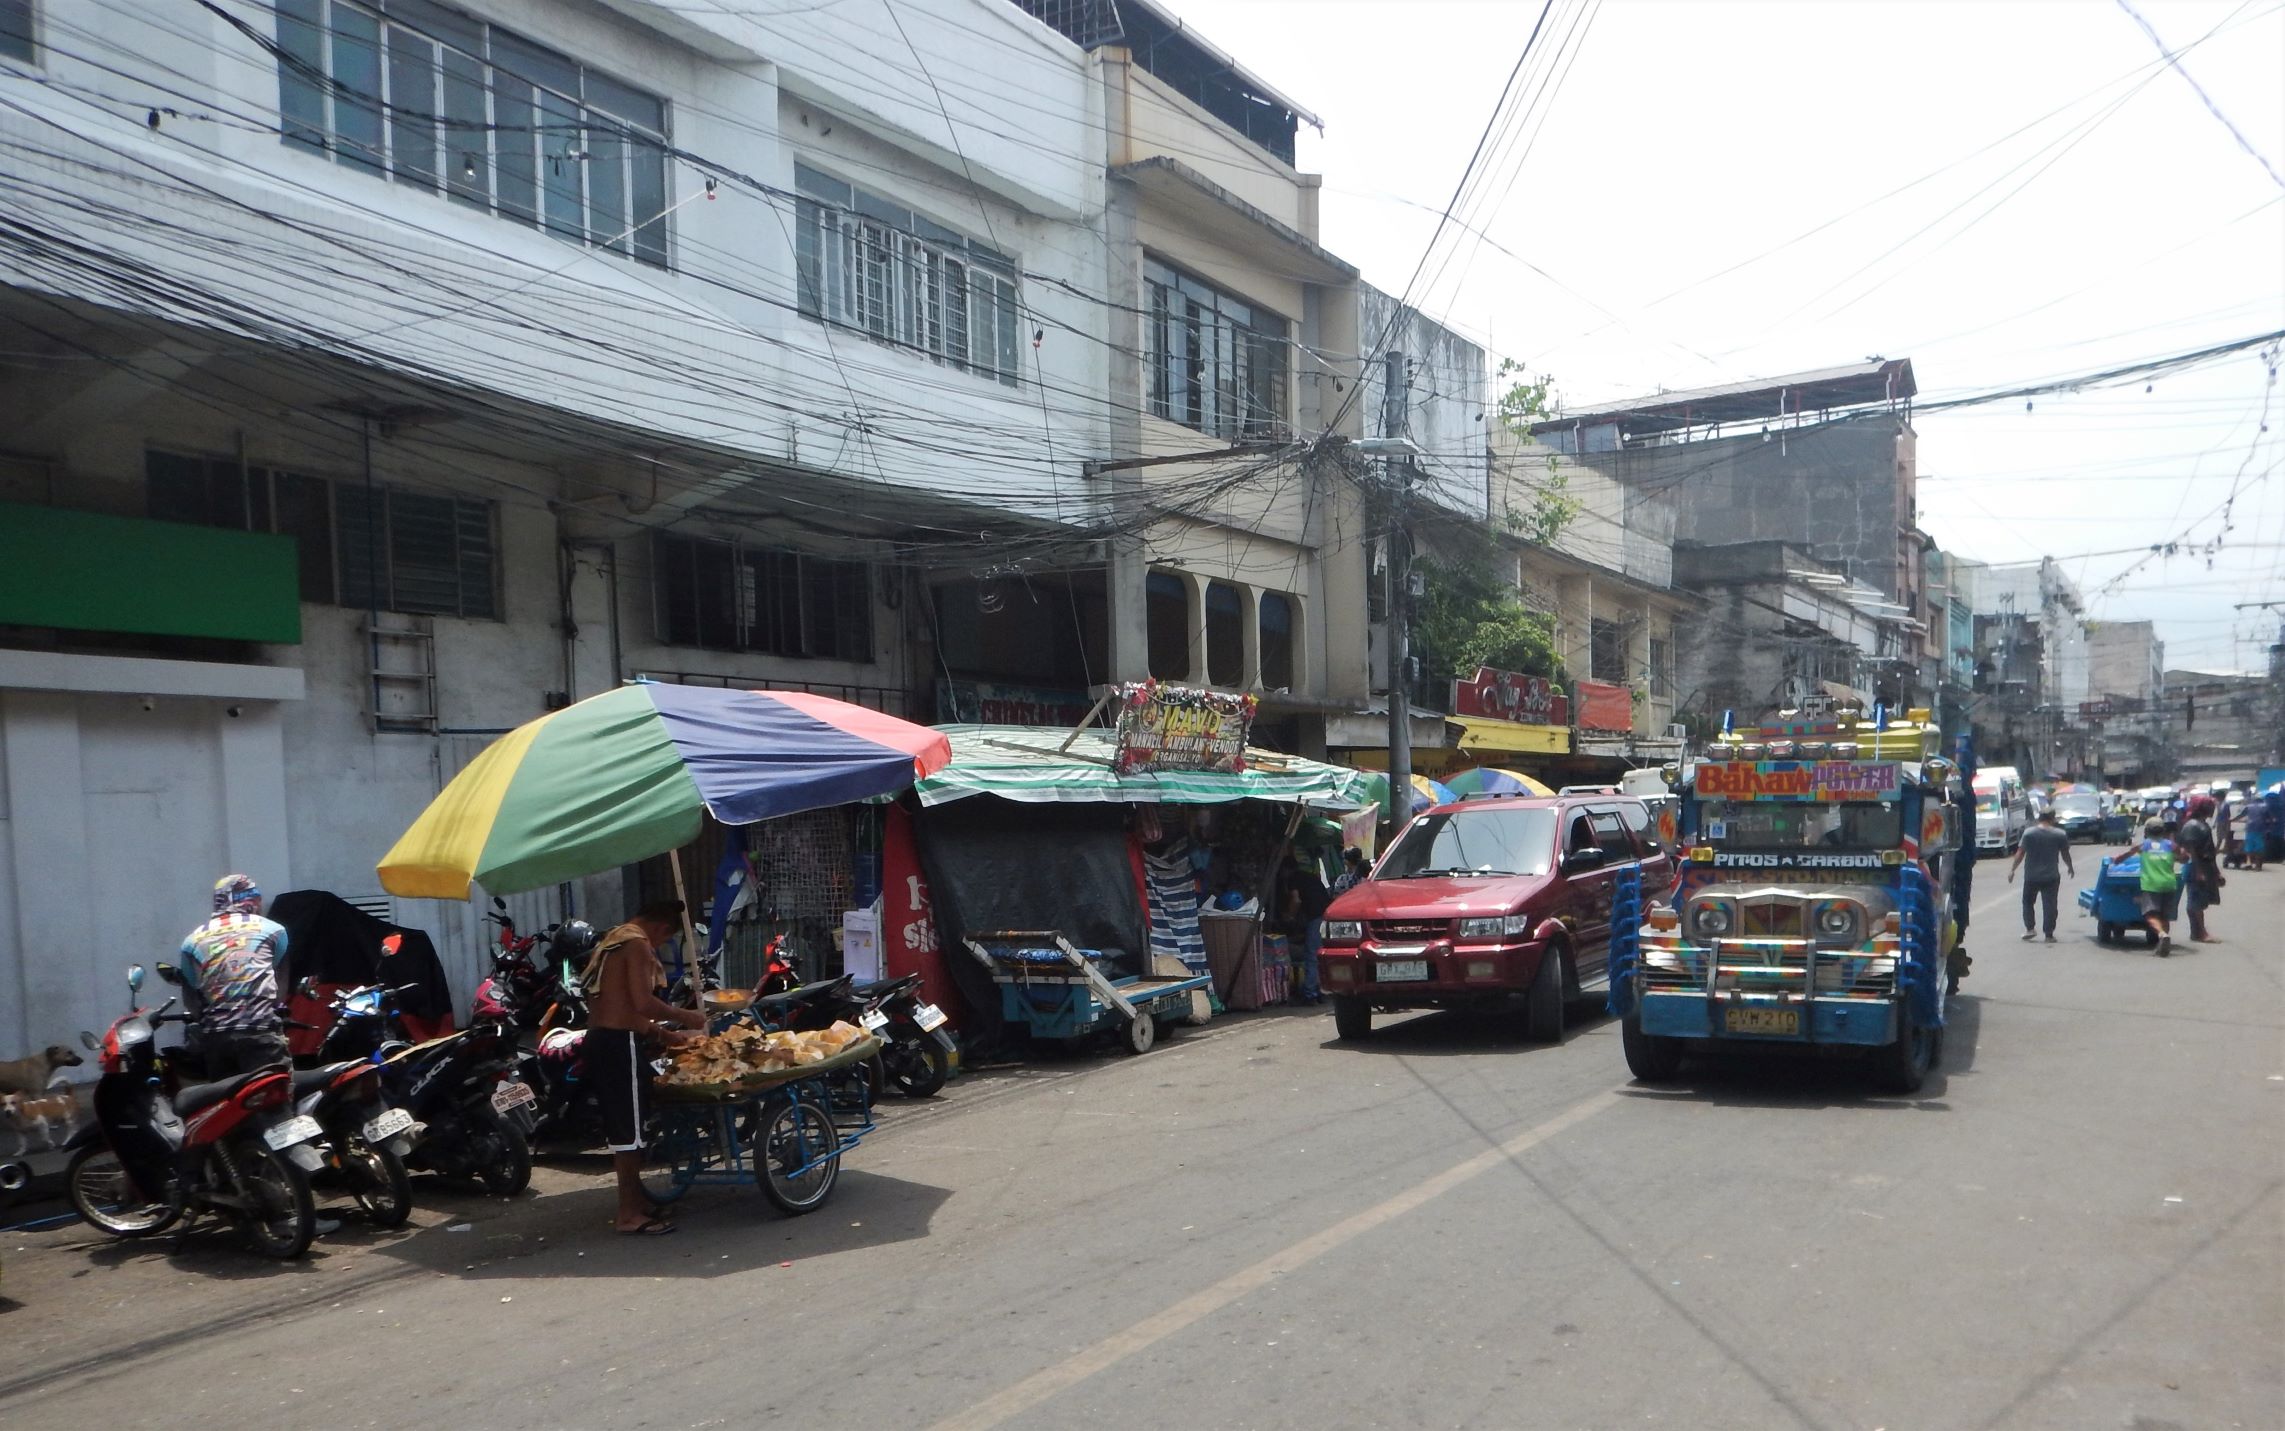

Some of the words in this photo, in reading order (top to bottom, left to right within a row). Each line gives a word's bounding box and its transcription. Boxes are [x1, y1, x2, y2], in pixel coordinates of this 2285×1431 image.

[1161, 704, 1221, 735] MAVO
[1697, 764, 1814, 794] Bahaw
[1812, 763, 1896, 792] POWER
[1713, 854, 1779, 867] PITOS
[1797, 854, 1882, 868] CARBON
